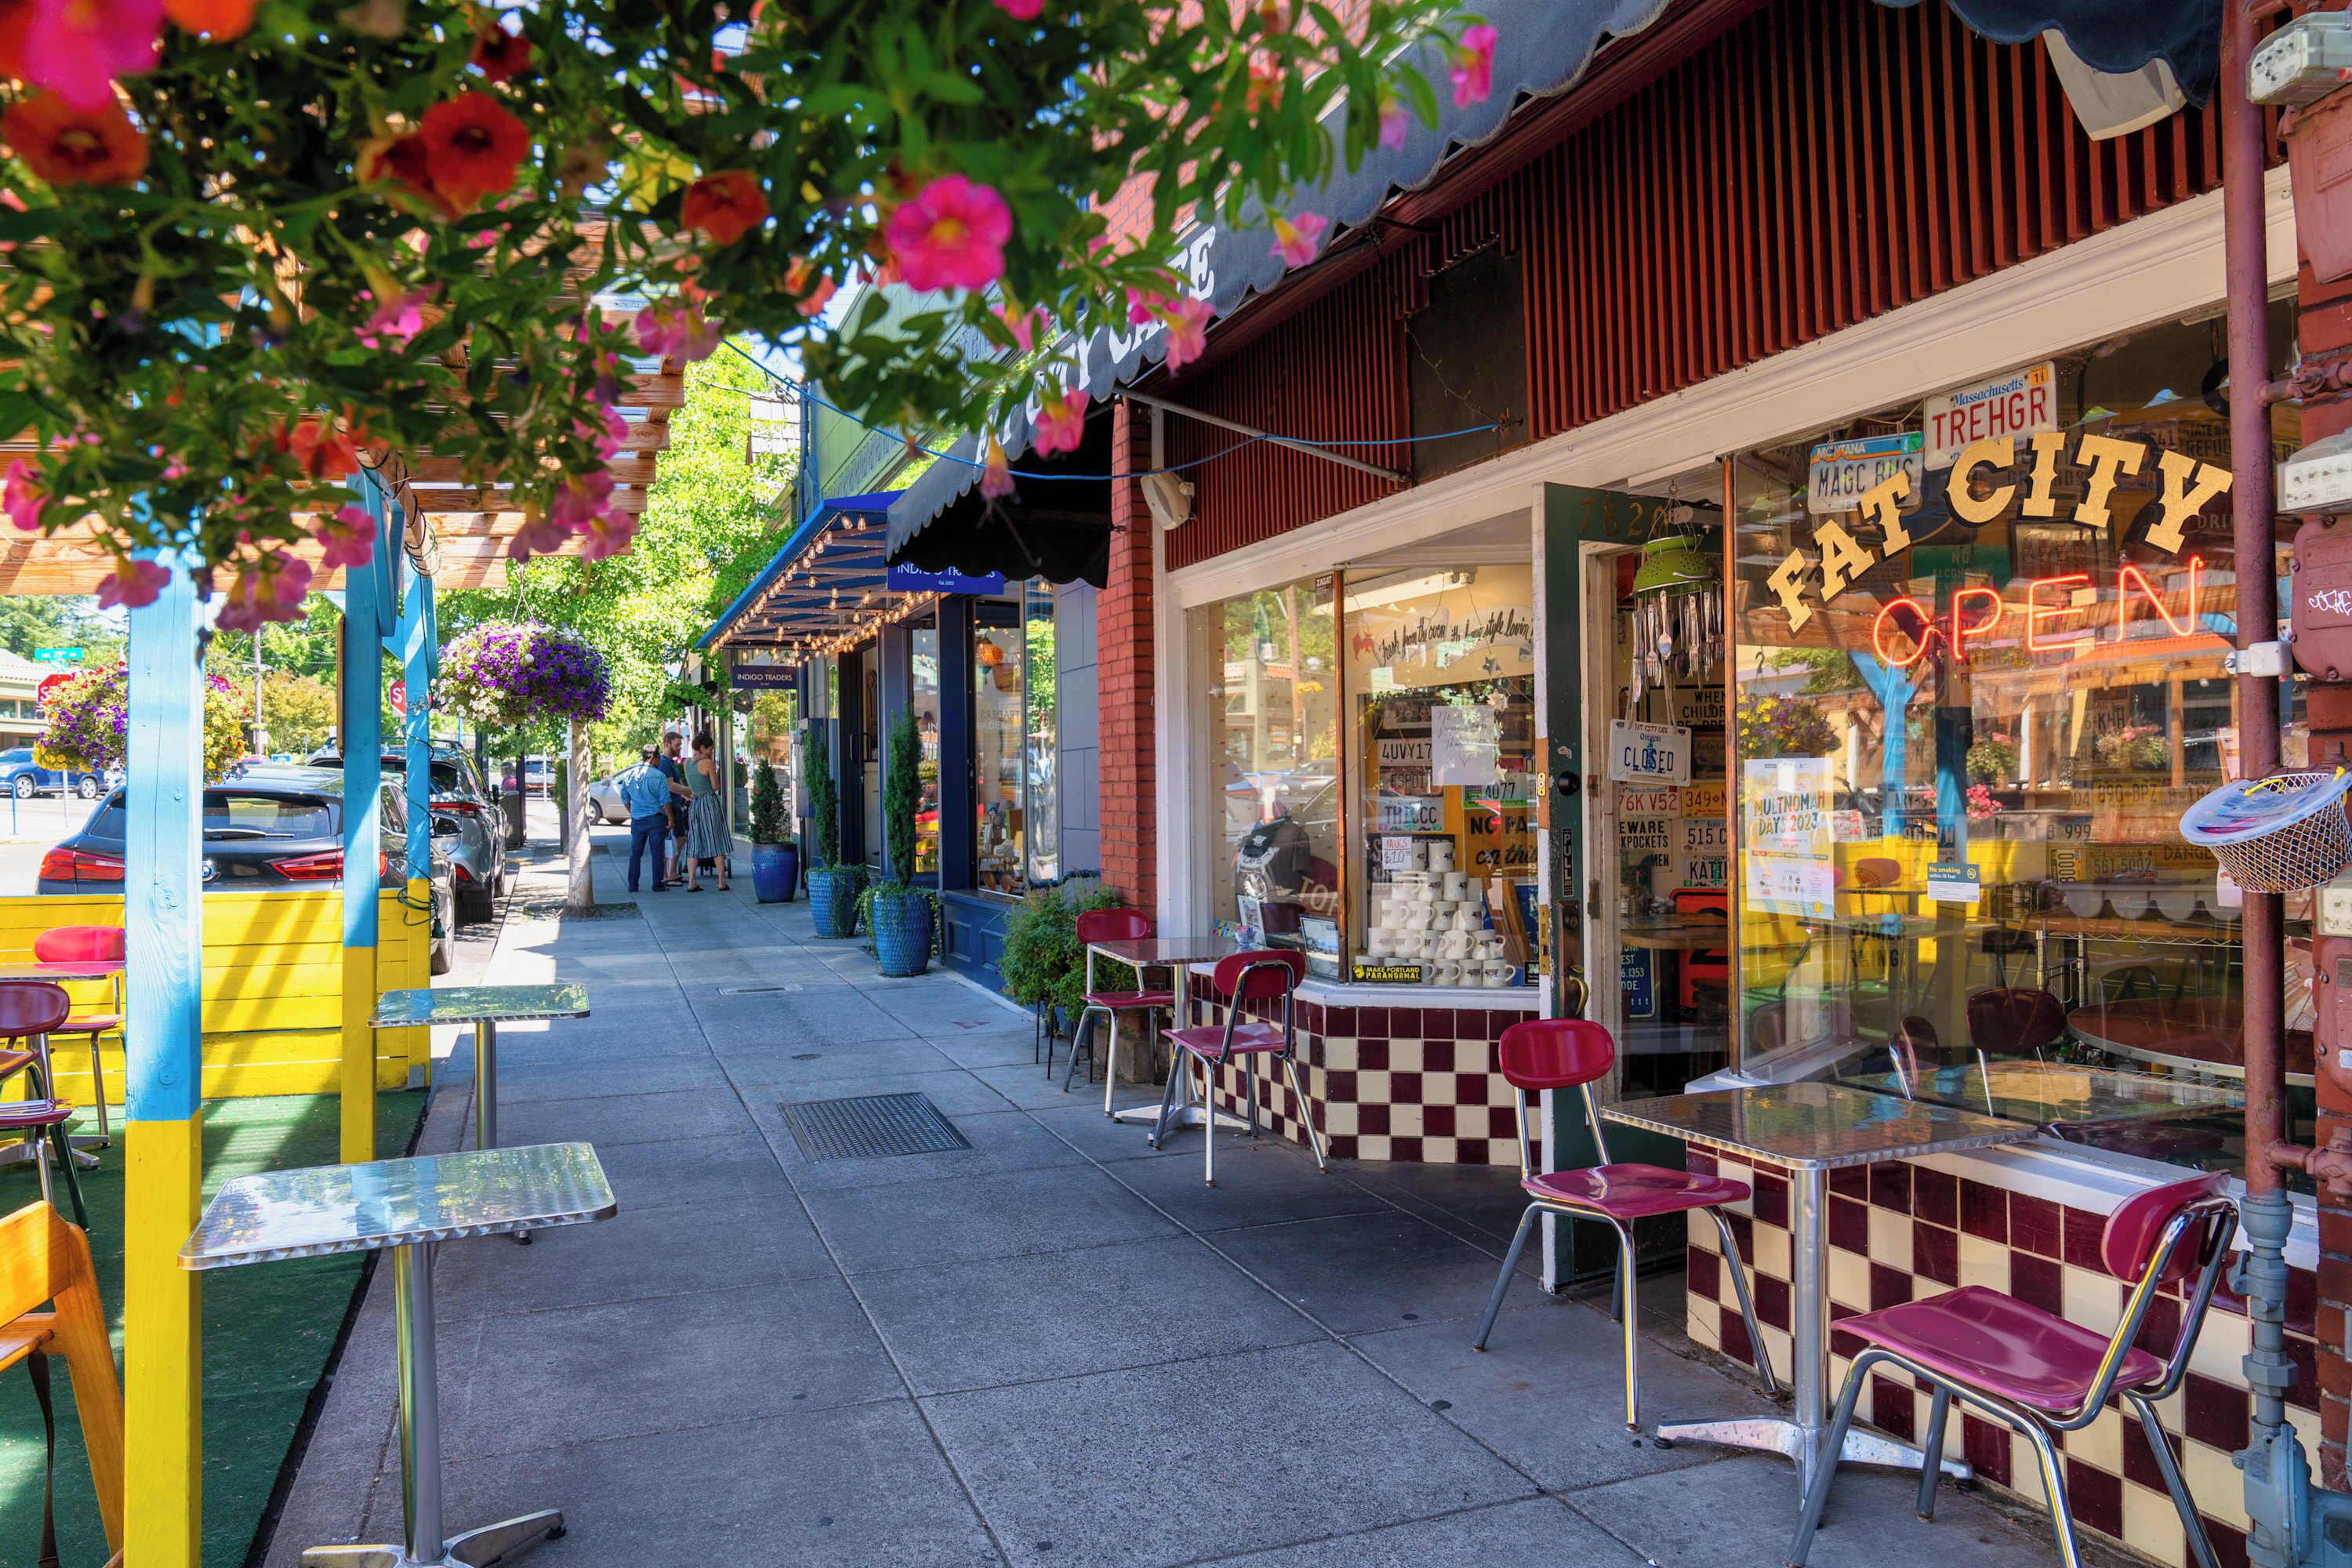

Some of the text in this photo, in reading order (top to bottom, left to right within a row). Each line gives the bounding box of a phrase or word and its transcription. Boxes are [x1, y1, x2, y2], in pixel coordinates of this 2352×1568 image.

[1953, 377, 2024, 408] Massachusetts
[1932, 386, 2047, 450] TREHGR
[1817, 442, 1866, 459] MONTANA
[1817, 463, 1866, 497] MAGC
[1766, 431, 2234, 633] FAT CITY
[1316, 575, 1332, 587] ZAGAT
[1872, 554, 2205, 667] OPEN
[1682, 705, 1726, 719] CHILDR
[1624, 746, 1674, 771] CLOSED
[1650, 793, 1678, 811] V52
[1754, 790, 1825, 816] MULTNOMAH
[1620, 821, 1665, 833] EWARE
[1759, 812, 1818, 836] DAYS 2023
[2065, 824, 2091, 840] 999
[1386, 838, 1408, 848] MUGS
[1621, 836, 1668, 848] KPOCKETS
[1688, 828, 1713, 844] 515
[1475, 841, 1538, 866] on thi
[1563, 833, 1572, 880] PULL
[1938, 866, 1961, 875] smoking
[1621, 955, 1635, 964] EST
[1621, 968, 1645, 978] 6.1353
